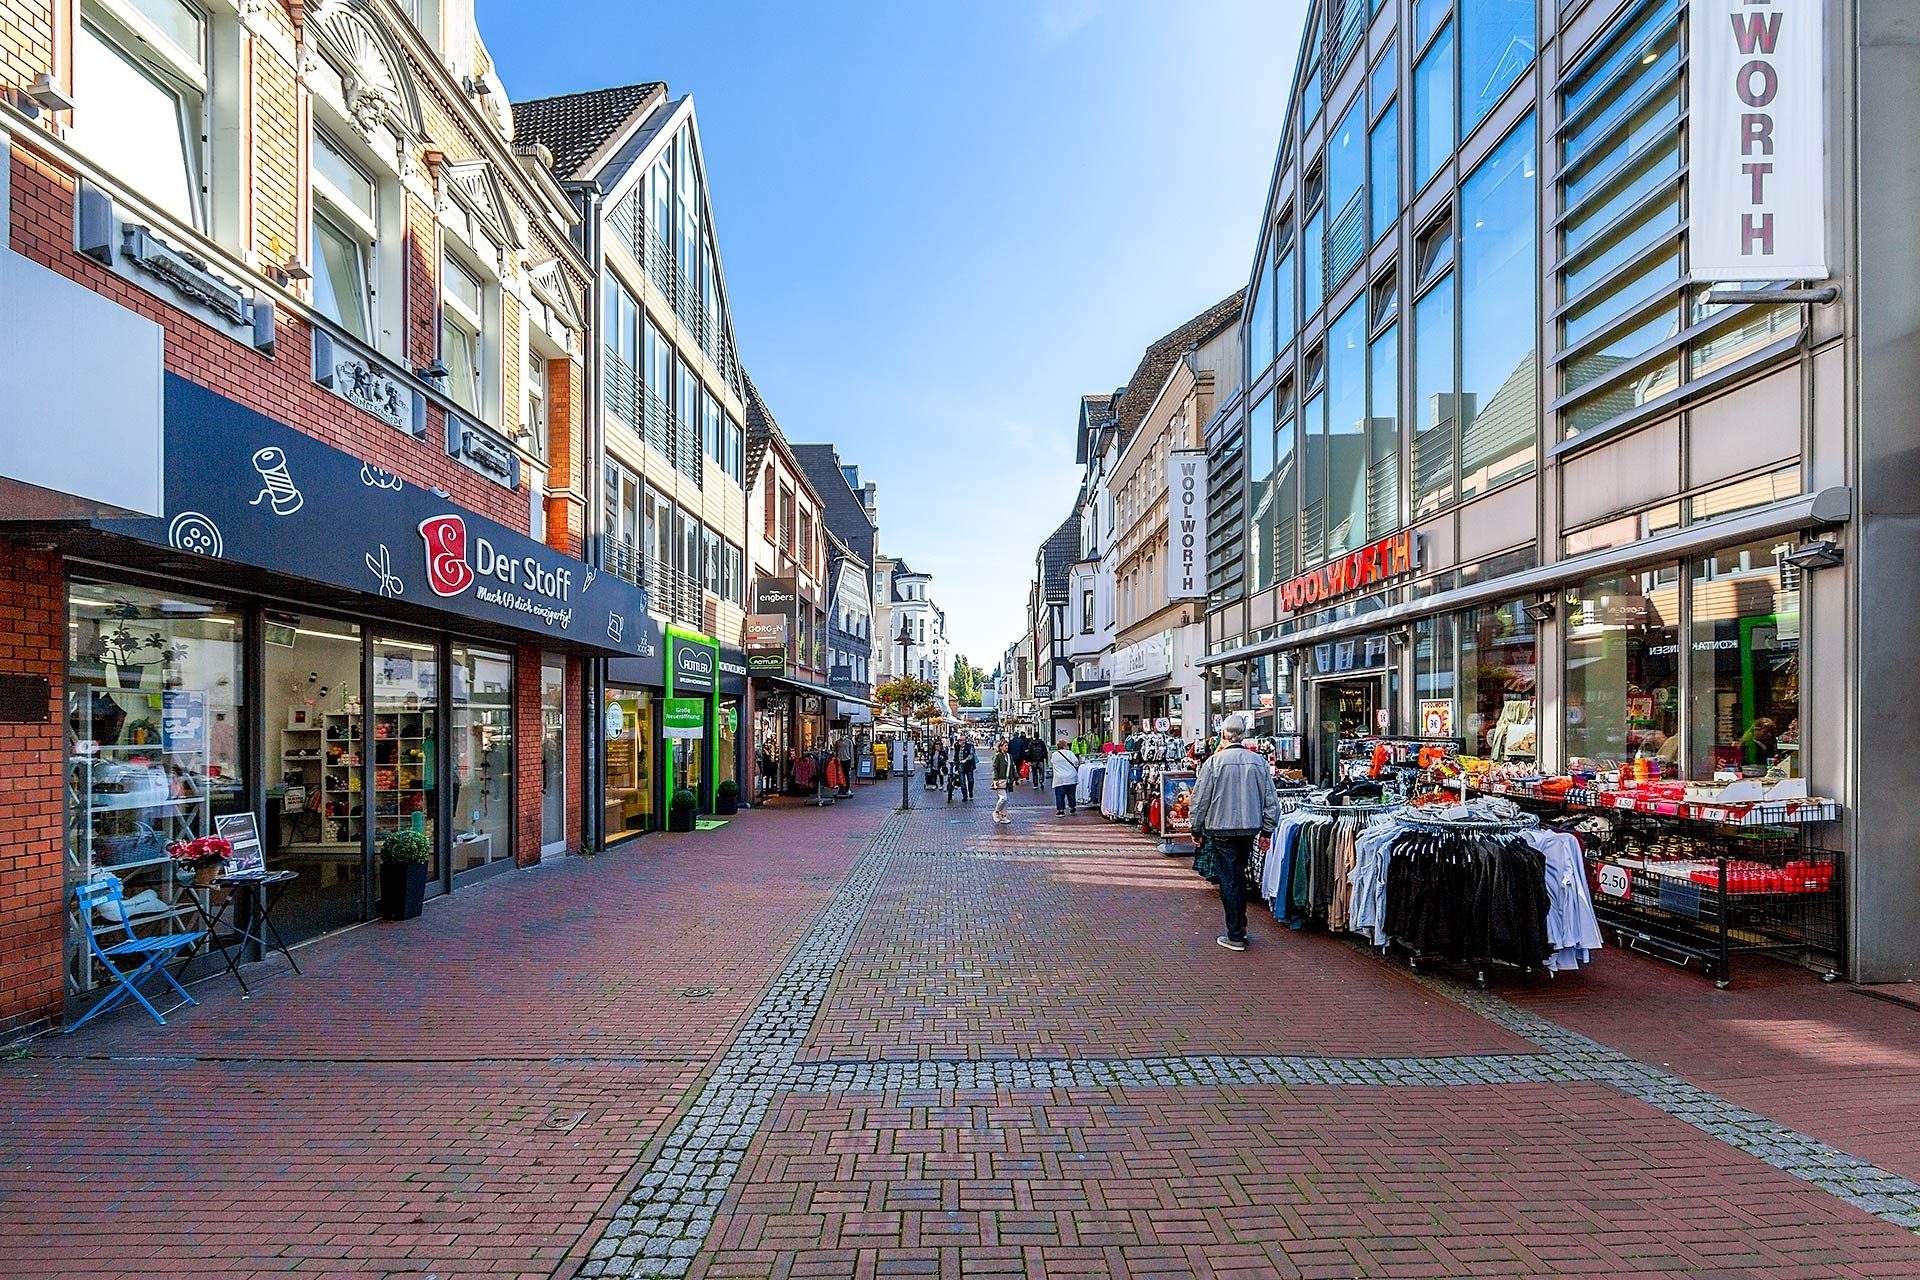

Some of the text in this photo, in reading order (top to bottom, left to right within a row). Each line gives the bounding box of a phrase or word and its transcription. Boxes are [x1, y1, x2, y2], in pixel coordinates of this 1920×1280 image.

[1730, 0, 1784, 255] WORTH
[1180, 463, 1196, 590] WOOLWORTH
[476, 537, 572, 602] Der Stoff
[1279, 530, 1411, 613] WOOLWORTH
[760, 593, 794, 603] engbers
[666, 713, 701, 721] Neueröffnung
[1430, 719, 1438, 729] 3€
[1619, 799, 1632, 808] 1.50
[1709, 810, 1720, 819] 1€
[1601, 872, 1627, 890] 2.50
